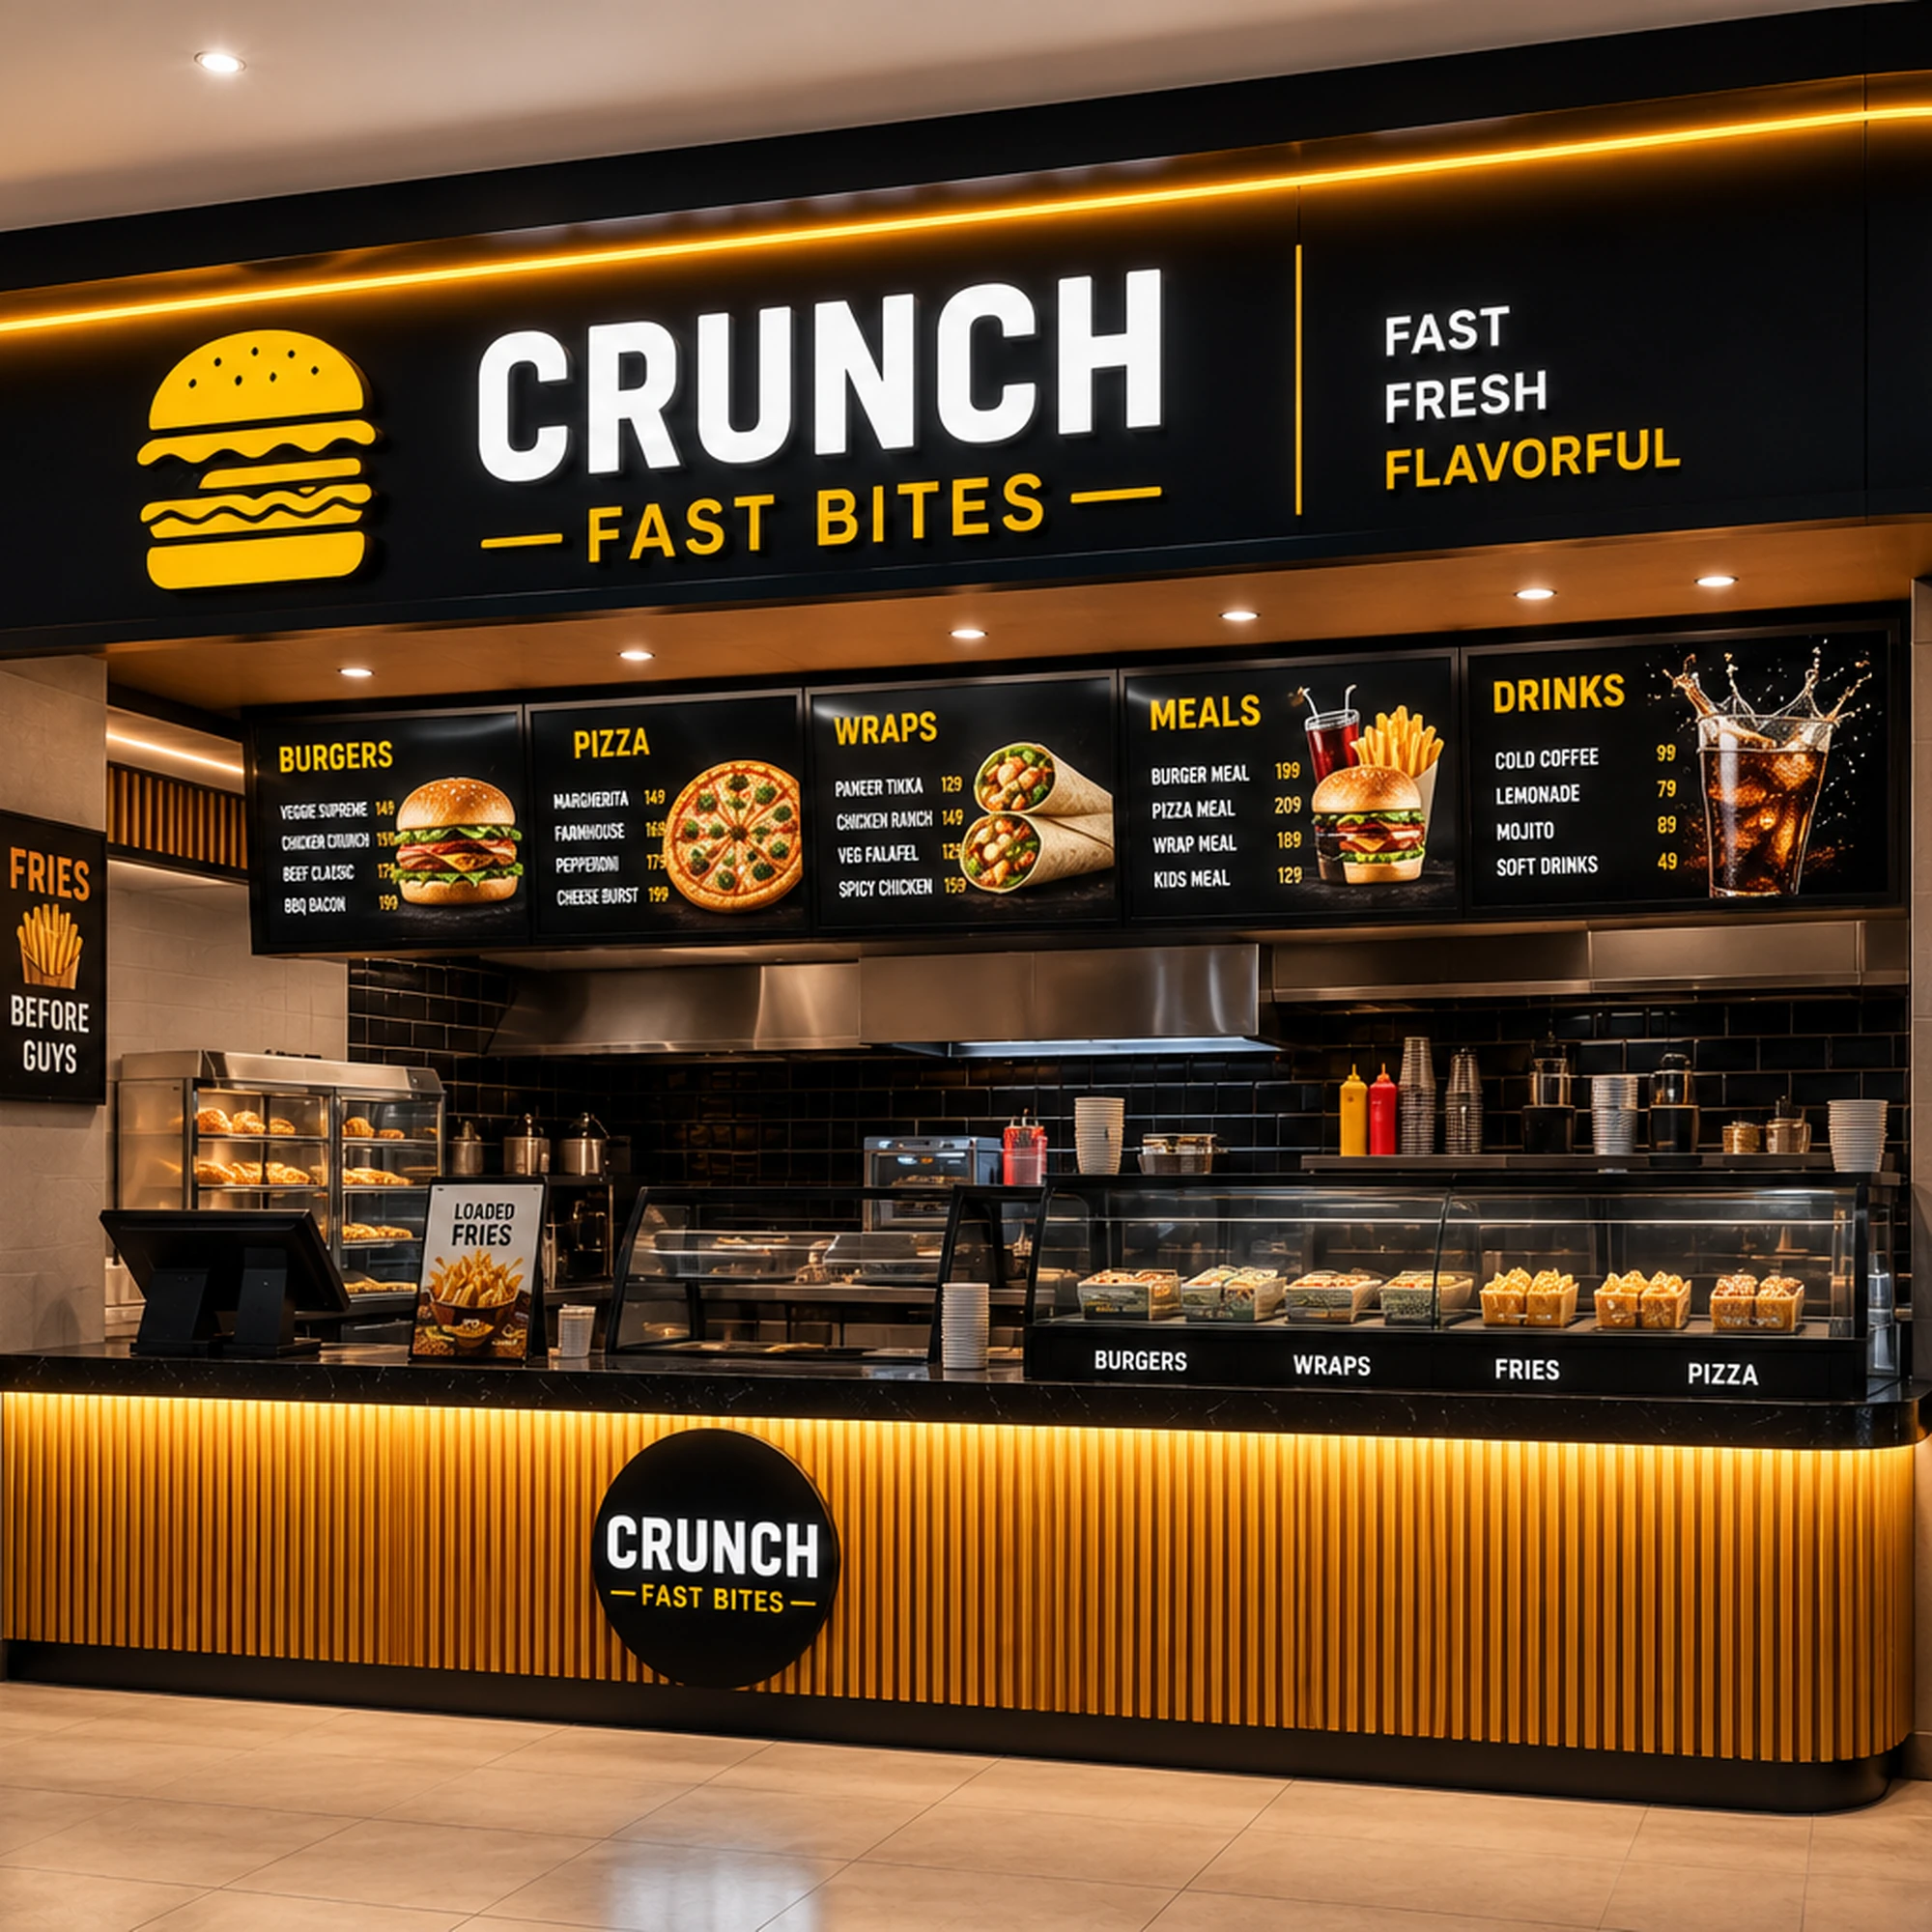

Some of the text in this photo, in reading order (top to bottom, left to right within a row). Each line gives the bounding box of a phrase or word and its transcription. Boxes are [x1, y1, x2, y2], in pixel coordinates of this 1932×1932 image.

[1385, 305, 1510, 357] FAST
[479, 269, 1161, 483] CRUNCH
[1385, 369, 1547, 424] FRESH
[1385, 427, 1682, 491] FLAVORFUL
[587, 472, 1045, 563] FAST BITES
[1493, 673, 1626, 714] DRINKS
[1150, 694, 1262, 730] MEALS
[834, 710, 938, 745] WRAPS
[573, 727, 650, 759] PIZZA
[279, 740, 393, 773] BURGERS
[1494, 744, 1677, 770] COLD COFFEE 99
[941, 776, 963, 794] 129
[1151, 761, 1301, 785] BURGER MEAL 199
[644, 788, 666, 805] 149
[1495, 781, 1677, 806] LEMONADE 79
[375, 800, 395, 816] 149
[942, 809, 964, 827] 149
[1151, 796, 1301, 819] PIZZA MEAL 209
[1496, 816, 1677, 841] MOJITO 89
[838, 846, 863, 865] VEG
[865, 843, 919, 863] FALAFEL
[1152, 831, 1302, 854] WRAP MEAL 189
[10, 846, 91, 901] FRIES
[282, 865, 308, 883] BEEF
[1496, 852, 1678, 877] SOFT DRINKS 49
[838, 880, 876, 898] SPICY
[878, 877, 933, 896] CHICKEN
[1153, 867, 1302, 889] KIDS MEAL 129
[284, 897, 306, 916] BBQ
[308, 895, 347, 913] BACON
[11, 994, 90, 1033] BEFORE
[23, 1039, 77, 1073] GUYS
[454, 1203, 515, 1220] LOADED
[451, 1224, 512, 1246] FRIES
[1094, 1350, 1188, 1372] BURGERS
[1293, 1354, 1372, 1377] WRAPS
[1494, 1358, 1560, 1381] FRIES
[1688, 1363, 1758, 1385] PIZZA
[607, 1515, 819, 1578] CRUNCH
[641, 1583, 784, 1613] FAST BITES
